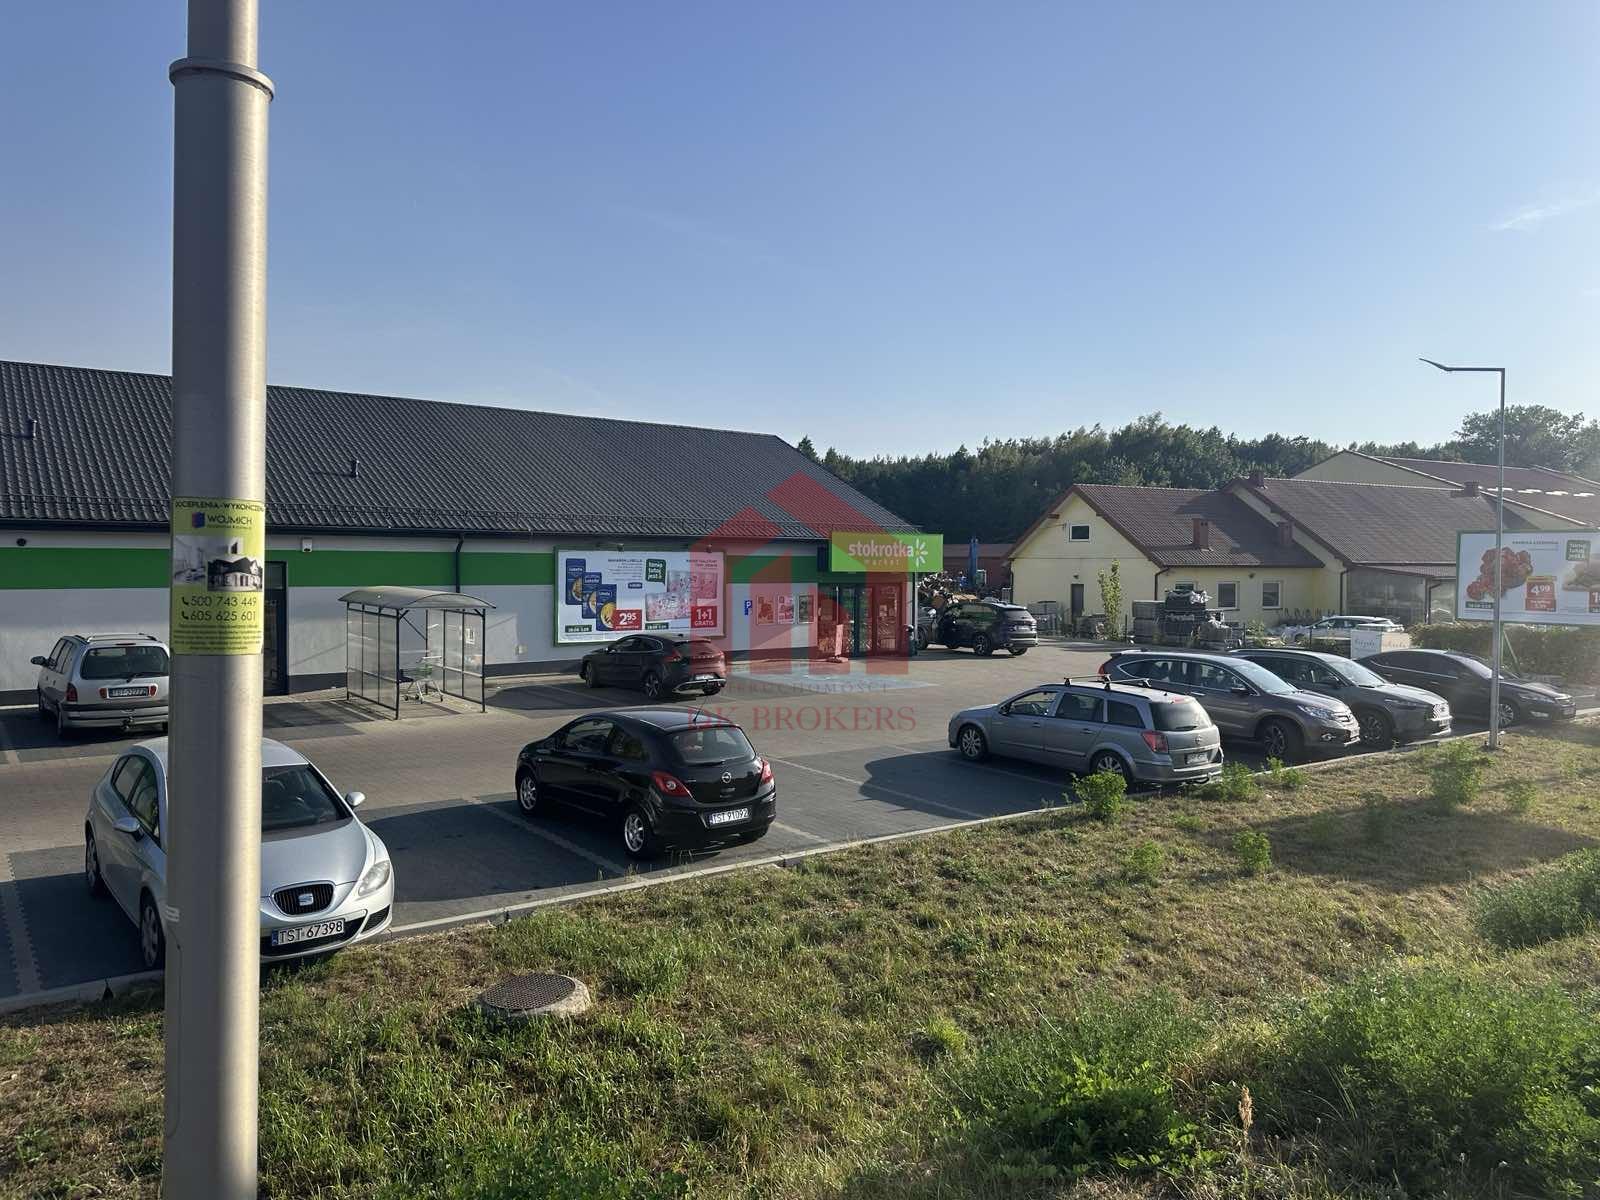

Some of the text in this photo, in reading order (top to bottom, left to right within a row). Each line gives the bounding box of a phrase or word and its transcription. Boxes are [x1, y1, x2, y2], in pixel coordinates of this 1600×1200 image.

[848, 540, 914, 557] stokrotka
[190, 596, 257, 607] 500 743 449
[190, 611, 256, 621] 605 625 601
[696, 608, 713, 620] 1+1
[280, 921, 343, 943] TST 67398
